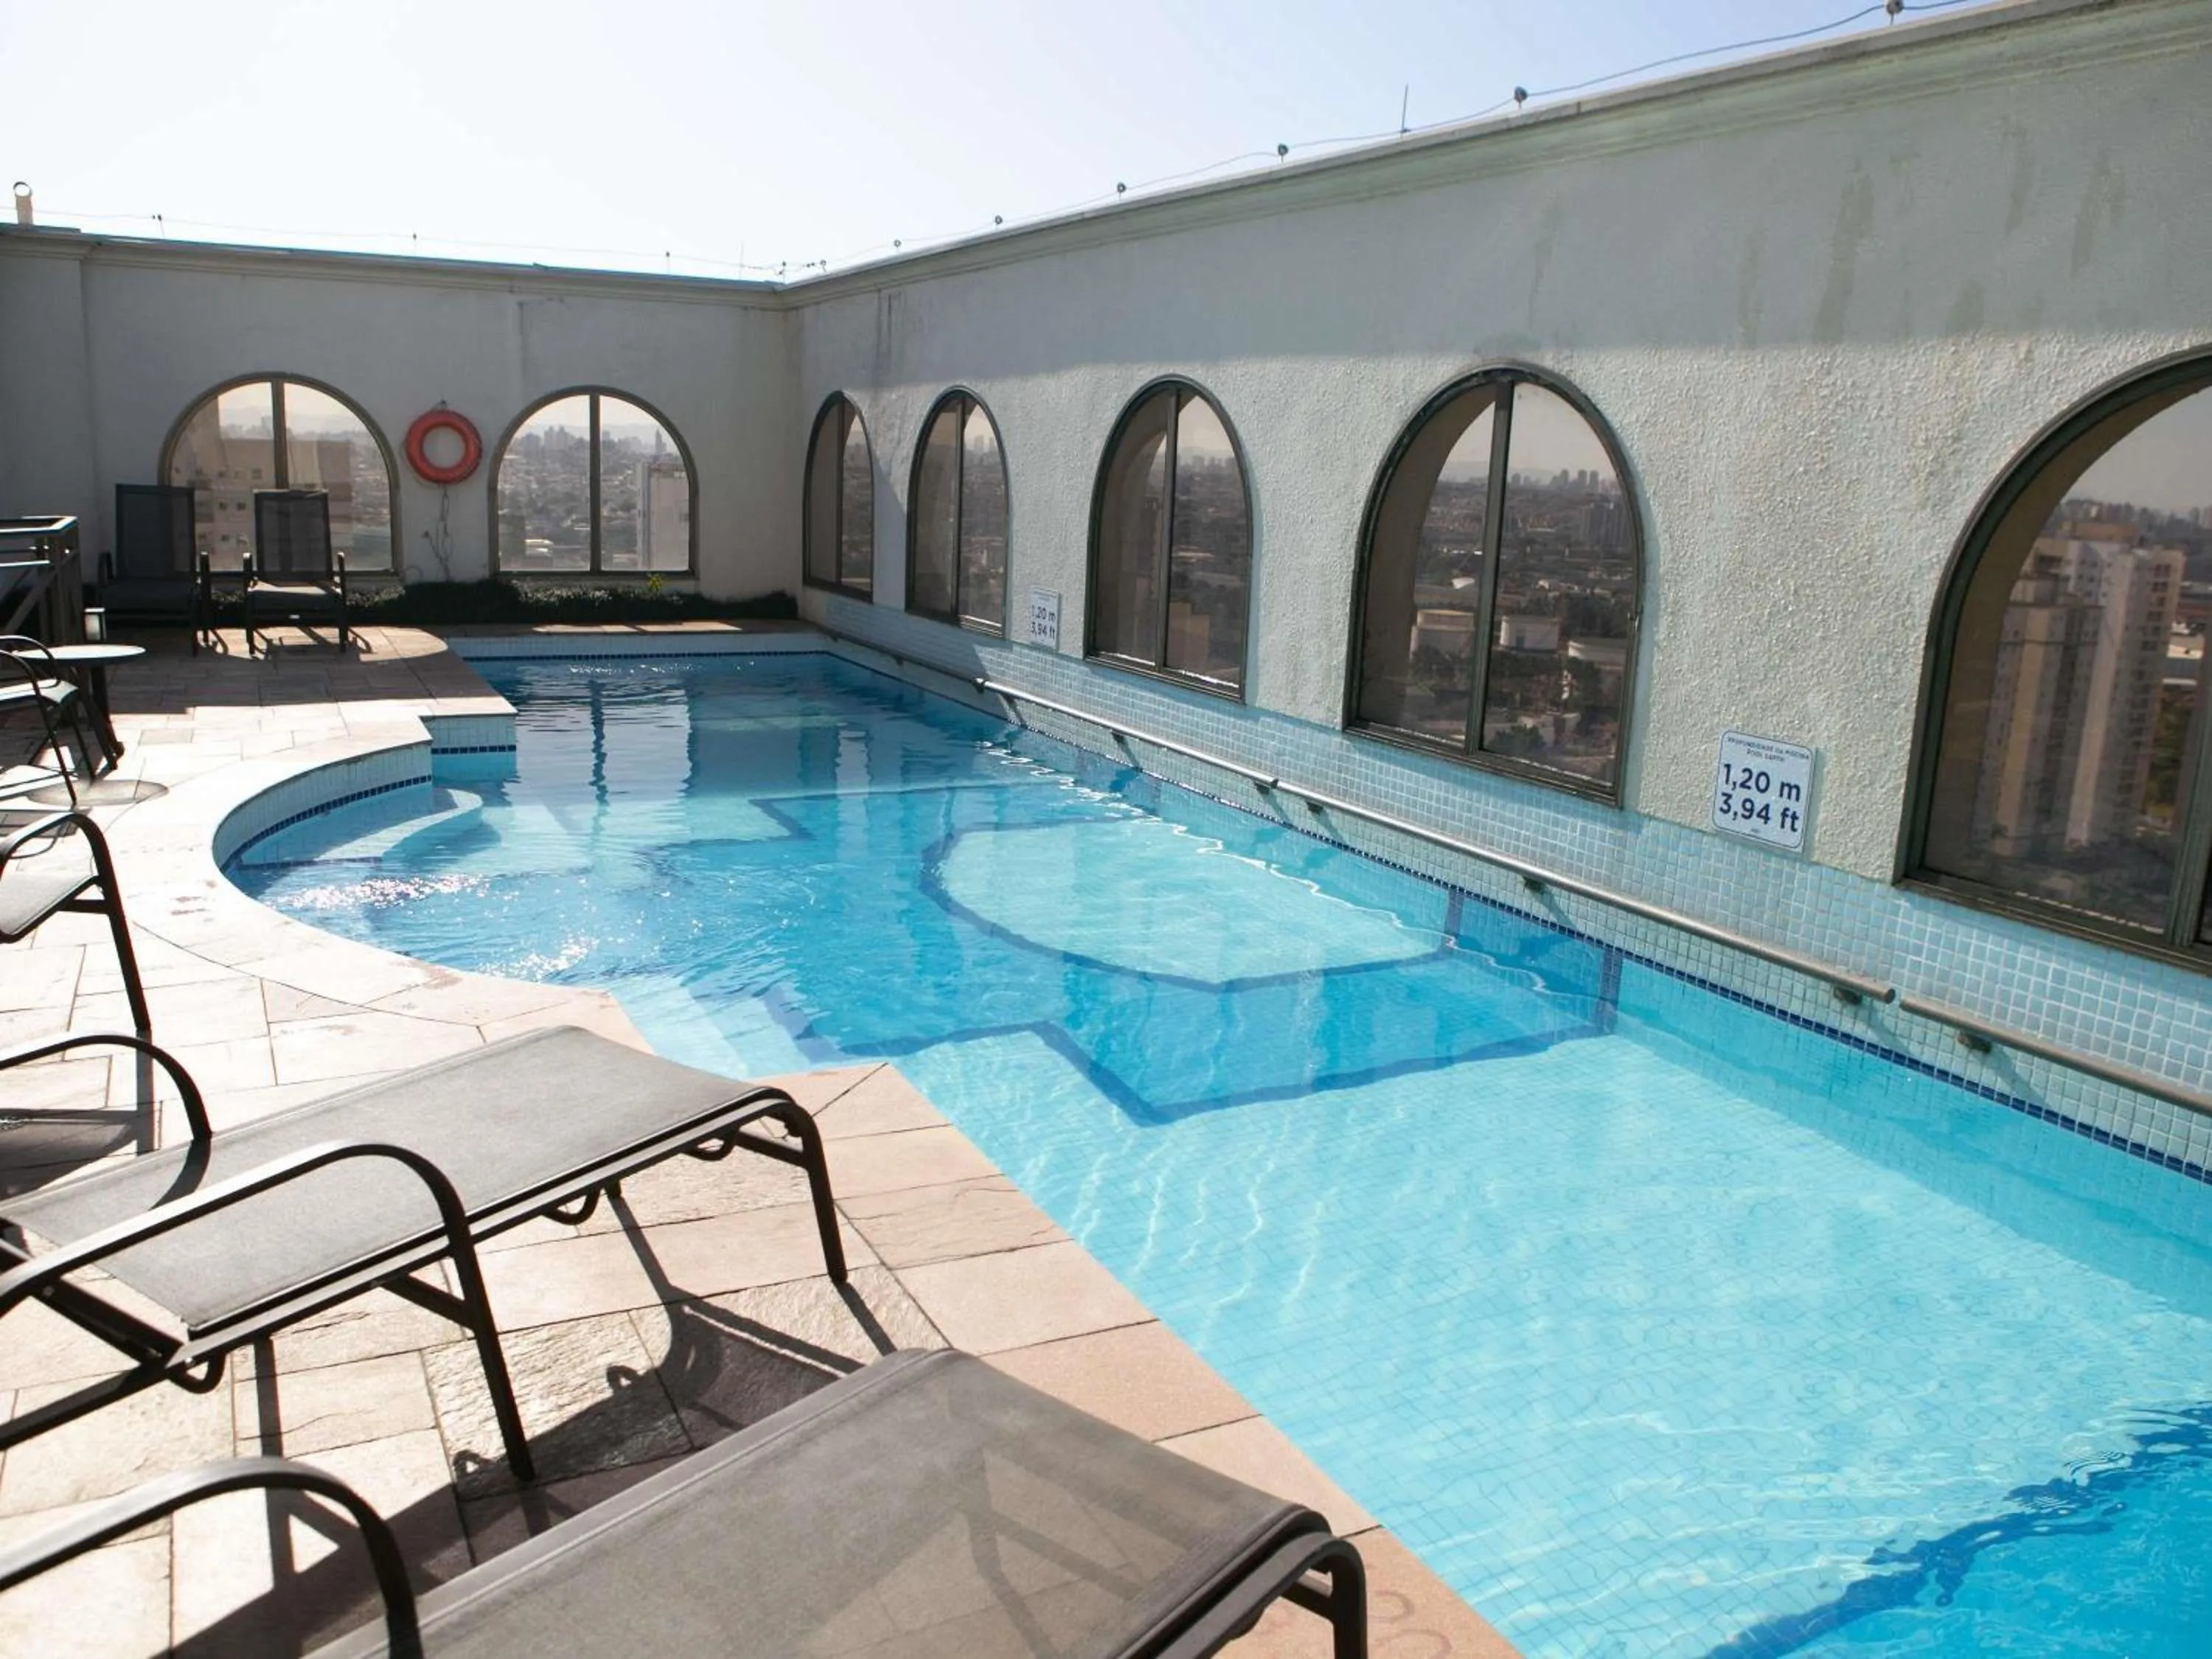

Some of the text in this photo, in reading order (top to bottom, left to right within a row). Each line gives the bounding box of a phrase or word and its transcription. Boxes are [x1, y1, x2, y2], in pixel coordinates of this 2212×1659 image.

[1724, 764, 1801, 802] 1,20 m
[1719, 791, 1799, 832] 3,94 ft
